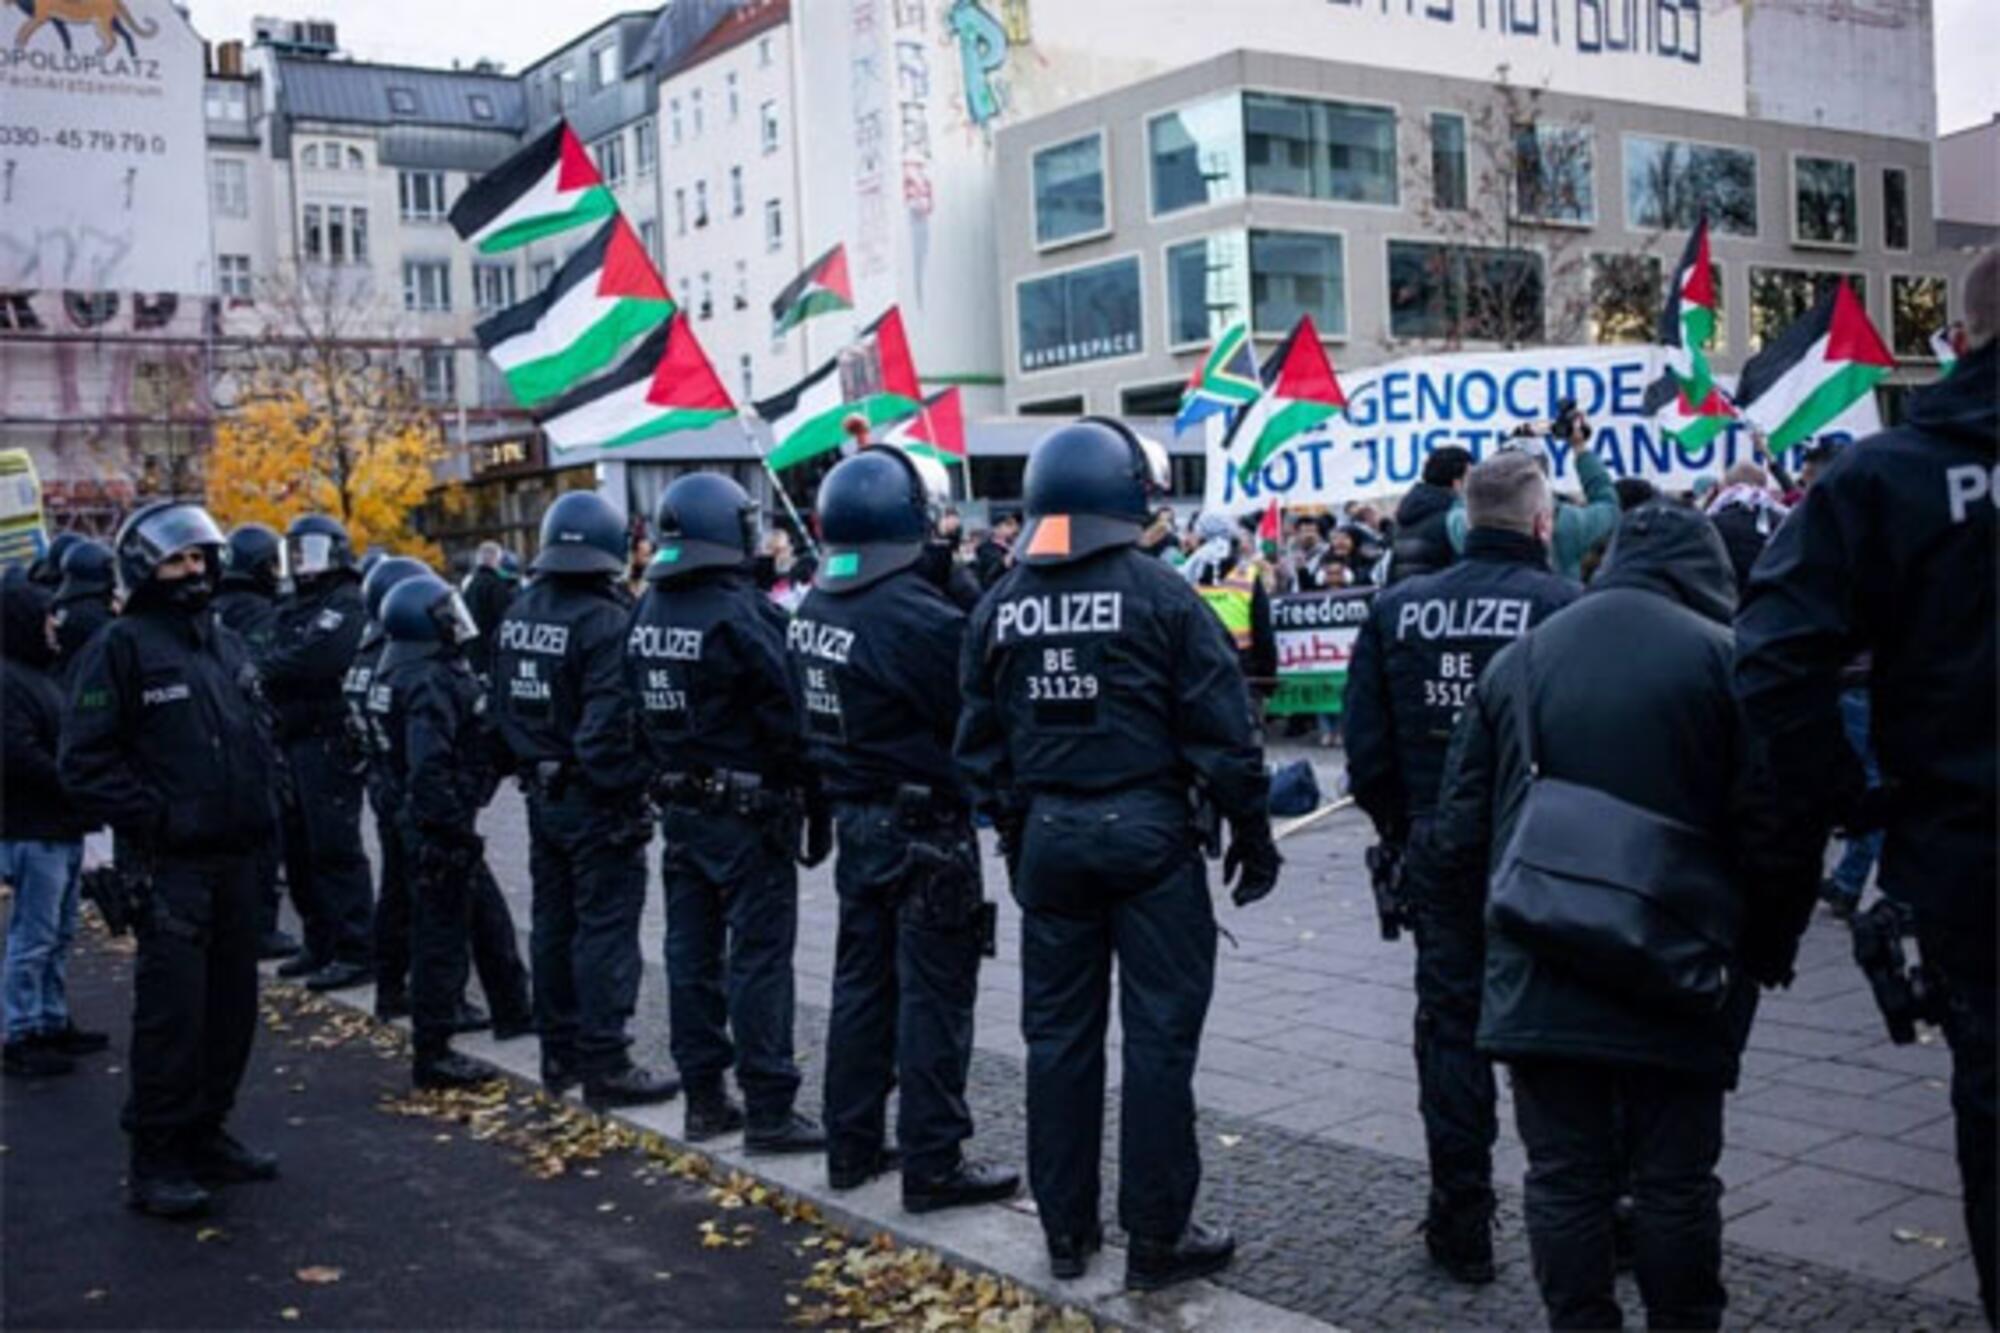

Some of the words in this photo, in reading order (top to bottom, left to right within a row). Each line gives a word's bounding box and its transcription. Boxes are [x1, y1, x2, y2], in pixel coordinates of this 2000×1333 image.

[1344, 363, 1643, 427] GENOCIDE
[1223, 440, 1332, 503] NOT
[997, 591, 1121, 641] POLIZEI
[1269, 594, 1370, 626] Freedom
[1397, 598, 1531, 641] POLIZEI
[499, 619, 569, 656] POLIZEI
[627, 625, 703, 661] POLIZEI
[786, 618, 855, 665] POLIZEI
[1044, 647, 1076, 672] BE
[1441, 653, 1473, 679] BE
[1027, 674, 1098, 699] 31129
